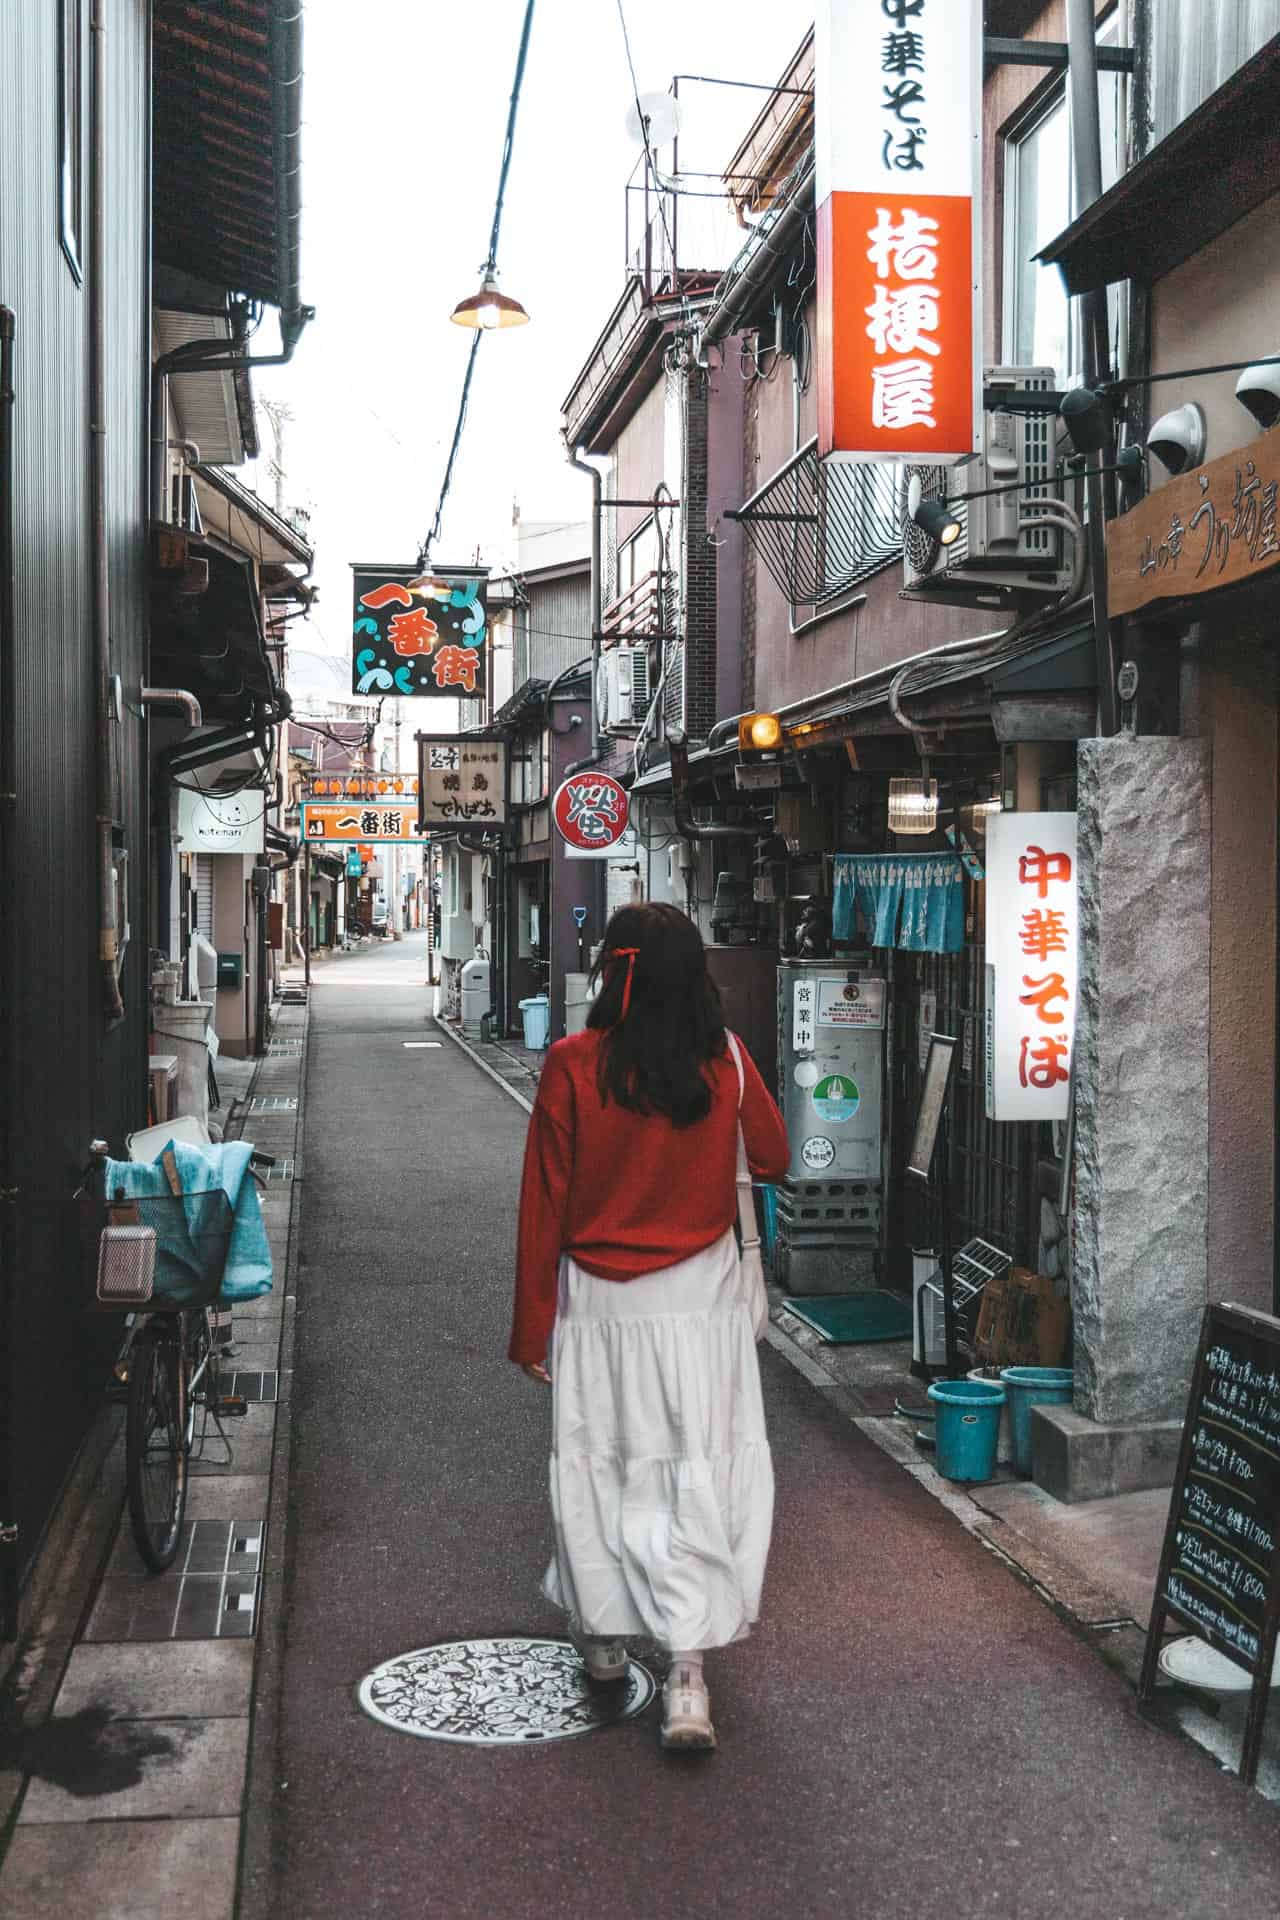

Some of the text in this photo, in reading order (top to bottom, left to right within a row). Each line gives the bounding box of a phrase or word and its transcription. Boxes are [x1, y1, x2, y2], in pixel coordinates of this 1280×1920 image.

[865, 208, 940, 429] 桔梗屋
[360, 583, 480, 692] 一番街
[337, 809, 402, 835] 一番街
[797, 987, 811, 1045] 営業中
[1018, 845, 1072, 1088] 中華そば
